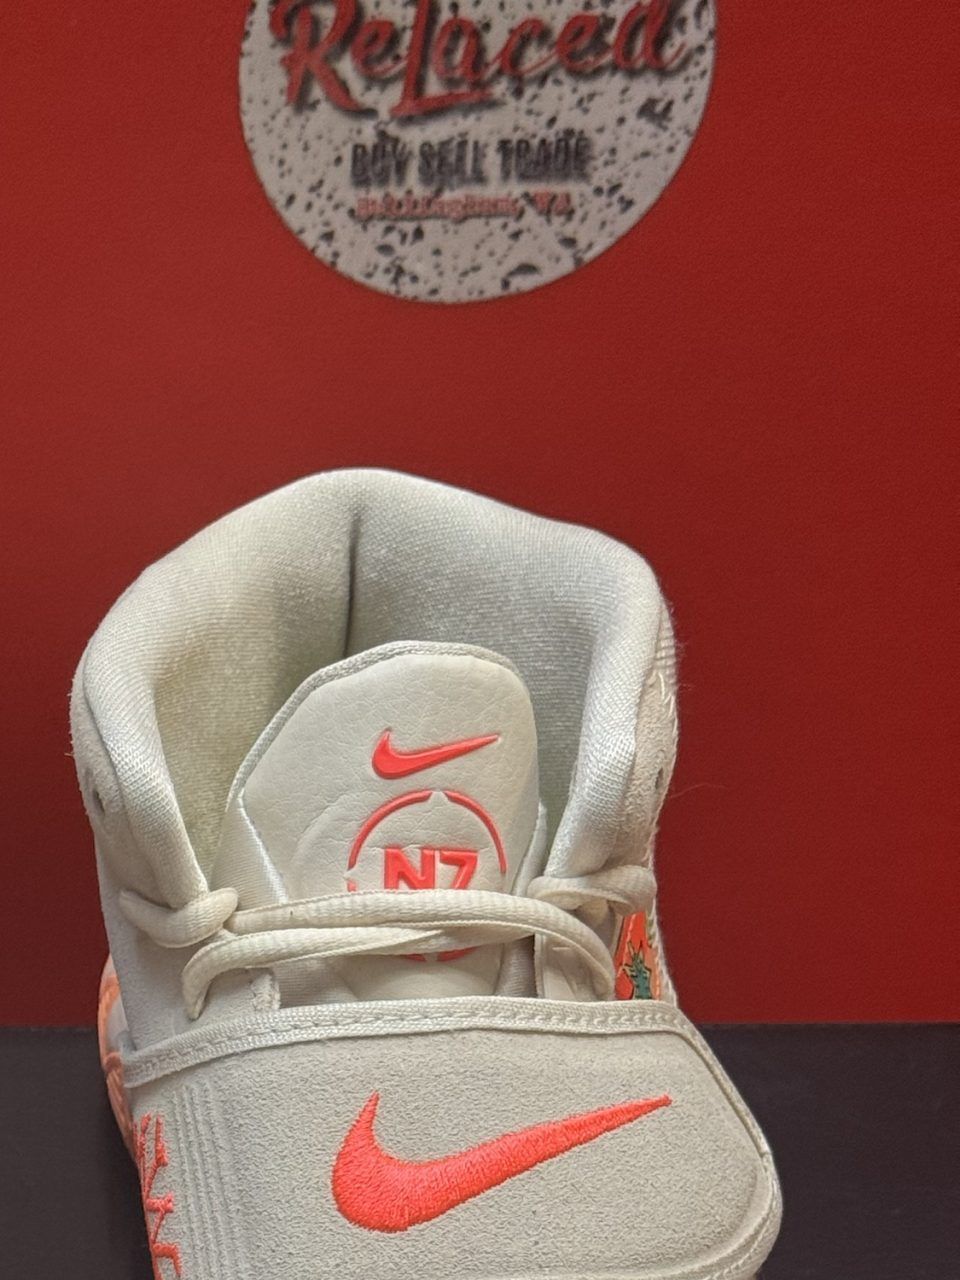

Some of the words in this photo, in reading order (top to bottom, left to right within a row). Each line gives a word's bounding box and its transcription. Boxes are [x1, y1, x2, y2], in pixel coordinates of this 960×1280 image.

[350, 138, 411, 187] BUY
[418, 138, 487, 187] SELL
[496, 136, 592, 184] TRADE
[383, 847, 478, 890] N7
